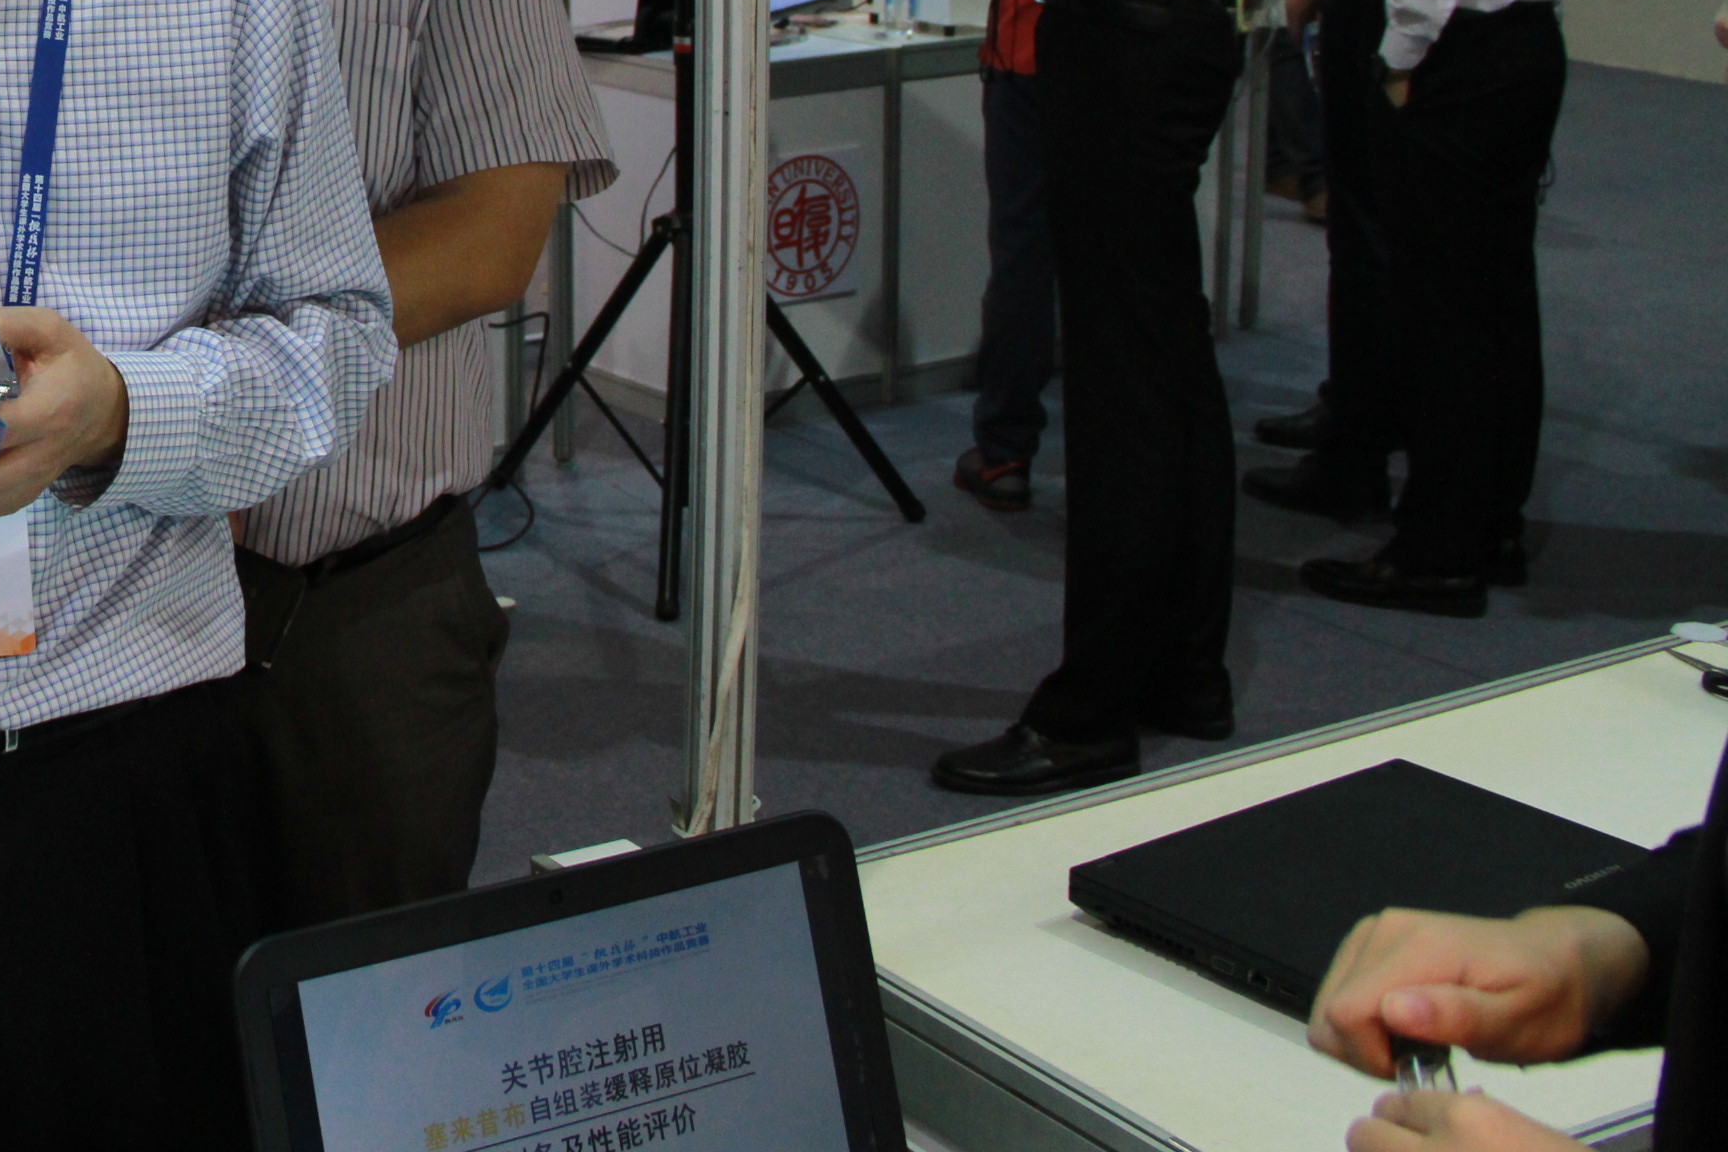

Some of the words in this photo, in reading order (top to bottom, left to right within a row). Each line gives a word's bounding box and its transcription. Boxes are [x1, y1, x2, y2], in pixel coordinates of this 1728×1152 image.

[781, 159, 856, 248] UNIVERSITY
[772, 261, 834, 291] 1905
[501, 1023, 667, 1095] 关节腔注射用
